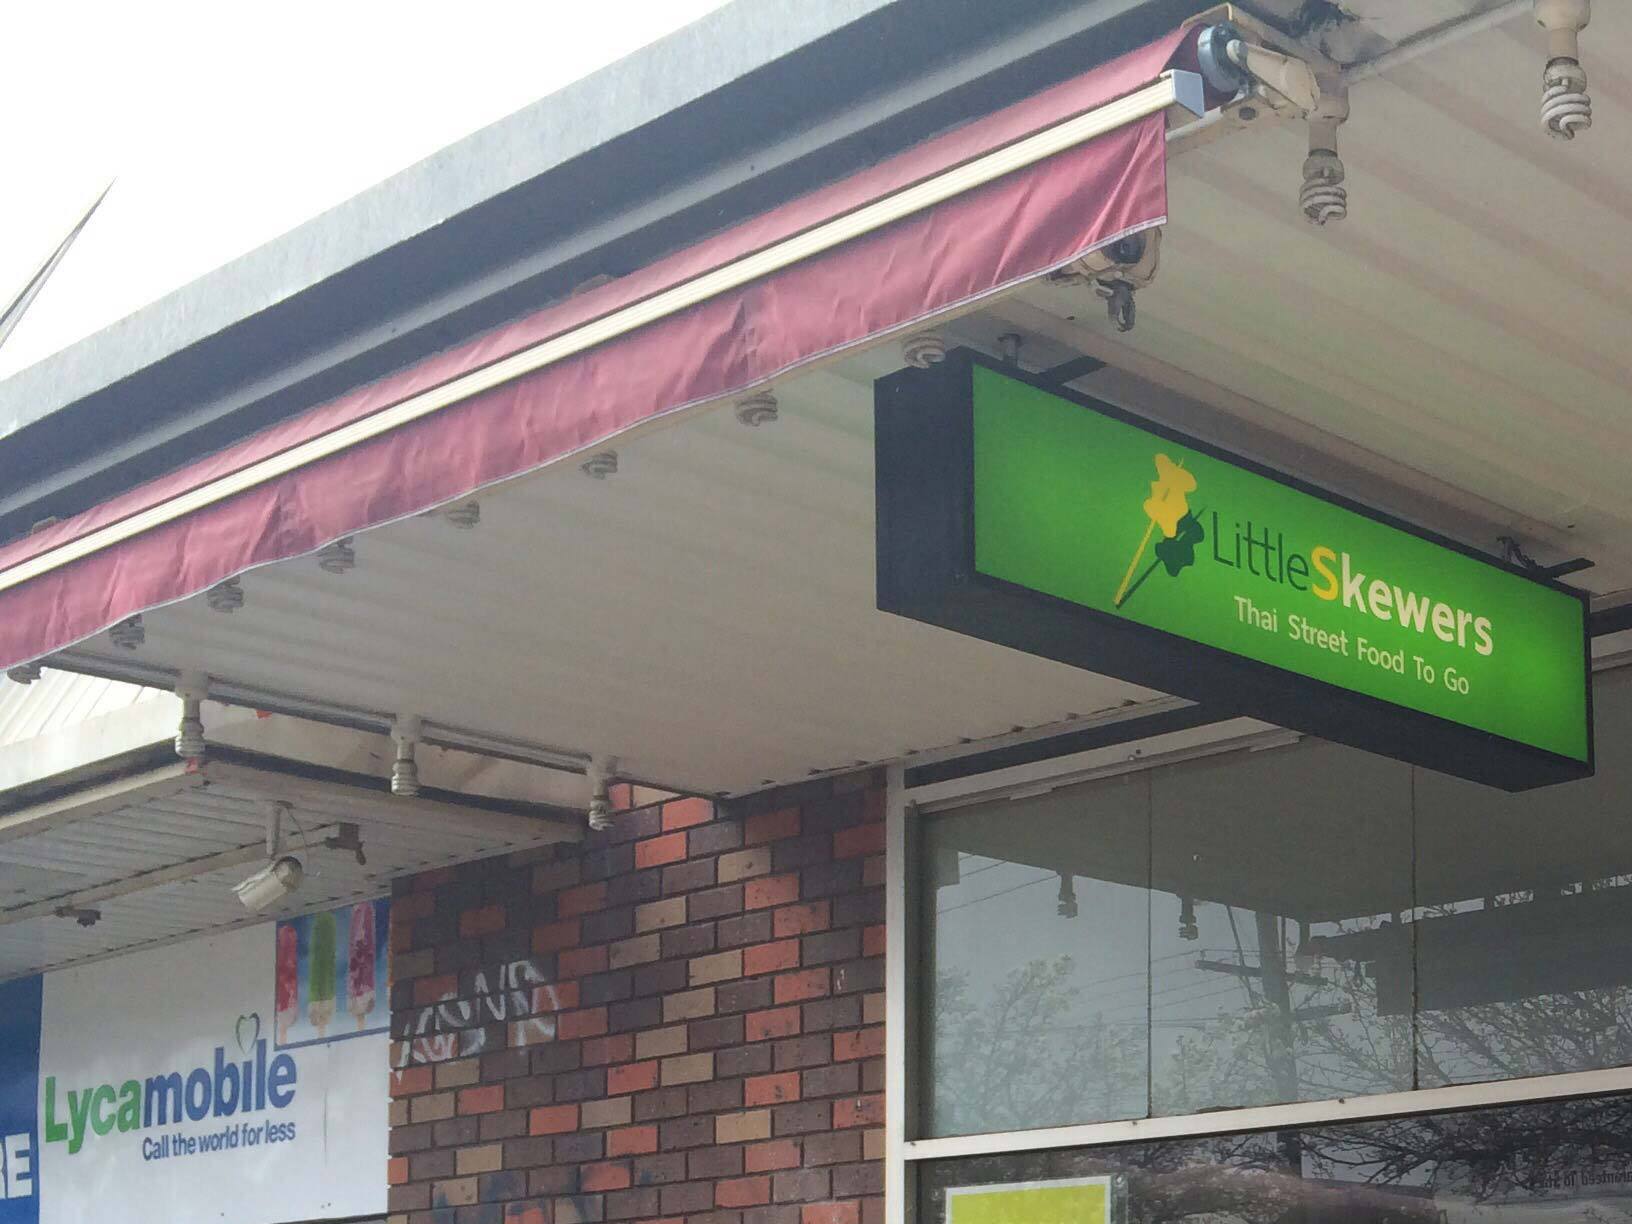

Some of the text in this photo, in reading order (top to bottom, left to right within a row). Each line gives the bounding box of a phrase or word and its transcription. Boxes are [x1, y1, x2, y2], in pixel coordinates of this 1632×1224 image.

[1234, 595, 1470, 695] Thai Street Food To Go
[45, 1038, 298, 1155] Lycamobile
[0, 1132, 32, 1198] E
[142, 1119, 297, 1161] Call the world for less
